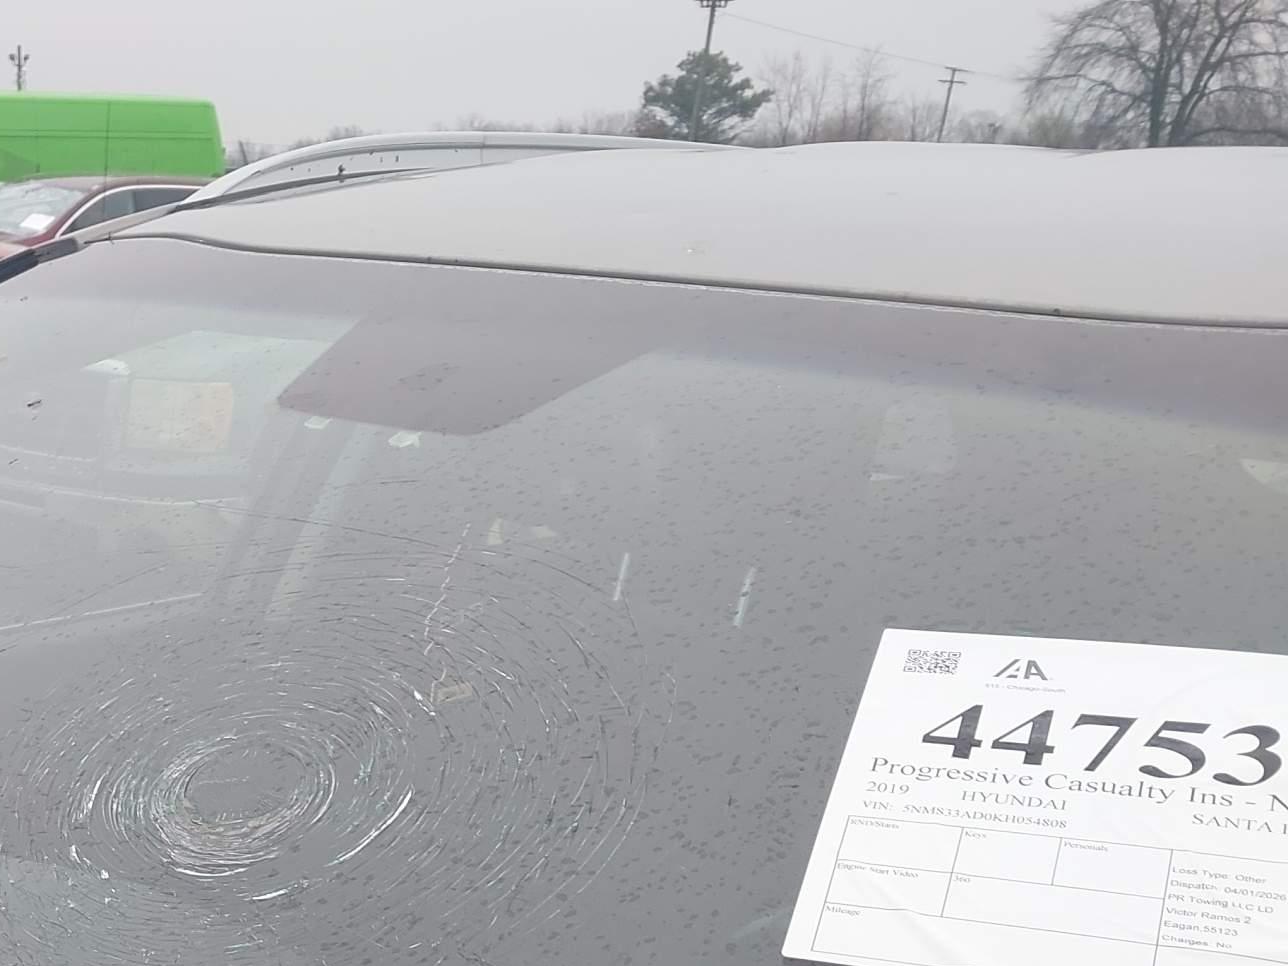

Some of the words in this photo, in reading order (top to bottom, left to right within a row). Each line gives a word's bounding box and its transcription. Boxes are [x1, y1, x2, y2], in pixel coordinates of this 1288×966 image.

[870, 757, 1034, 787] Progressive
[1044, 773, 1176, 804] Casualty
[1189, 786, 1234, 807] Ins
[862, 800, 894, 811] VIN:
[865, 781, 910, 795] 2019
[961, 790, 1068, 811] HYUNDAI
[1192, 813, 1273, 833] SANTA
[1172, 866, 1198, 875] Loss
[1235, 874, 1267, 884] Other
[1189, 895, 1228, 908] Towing
[1224, 886, 1288, 901] 04/01/2026
[1166, 907, 1198, 918] Victor
[1201, 911, 1240, 923] Ramos
[1243, 916, 1252, 924] 2
